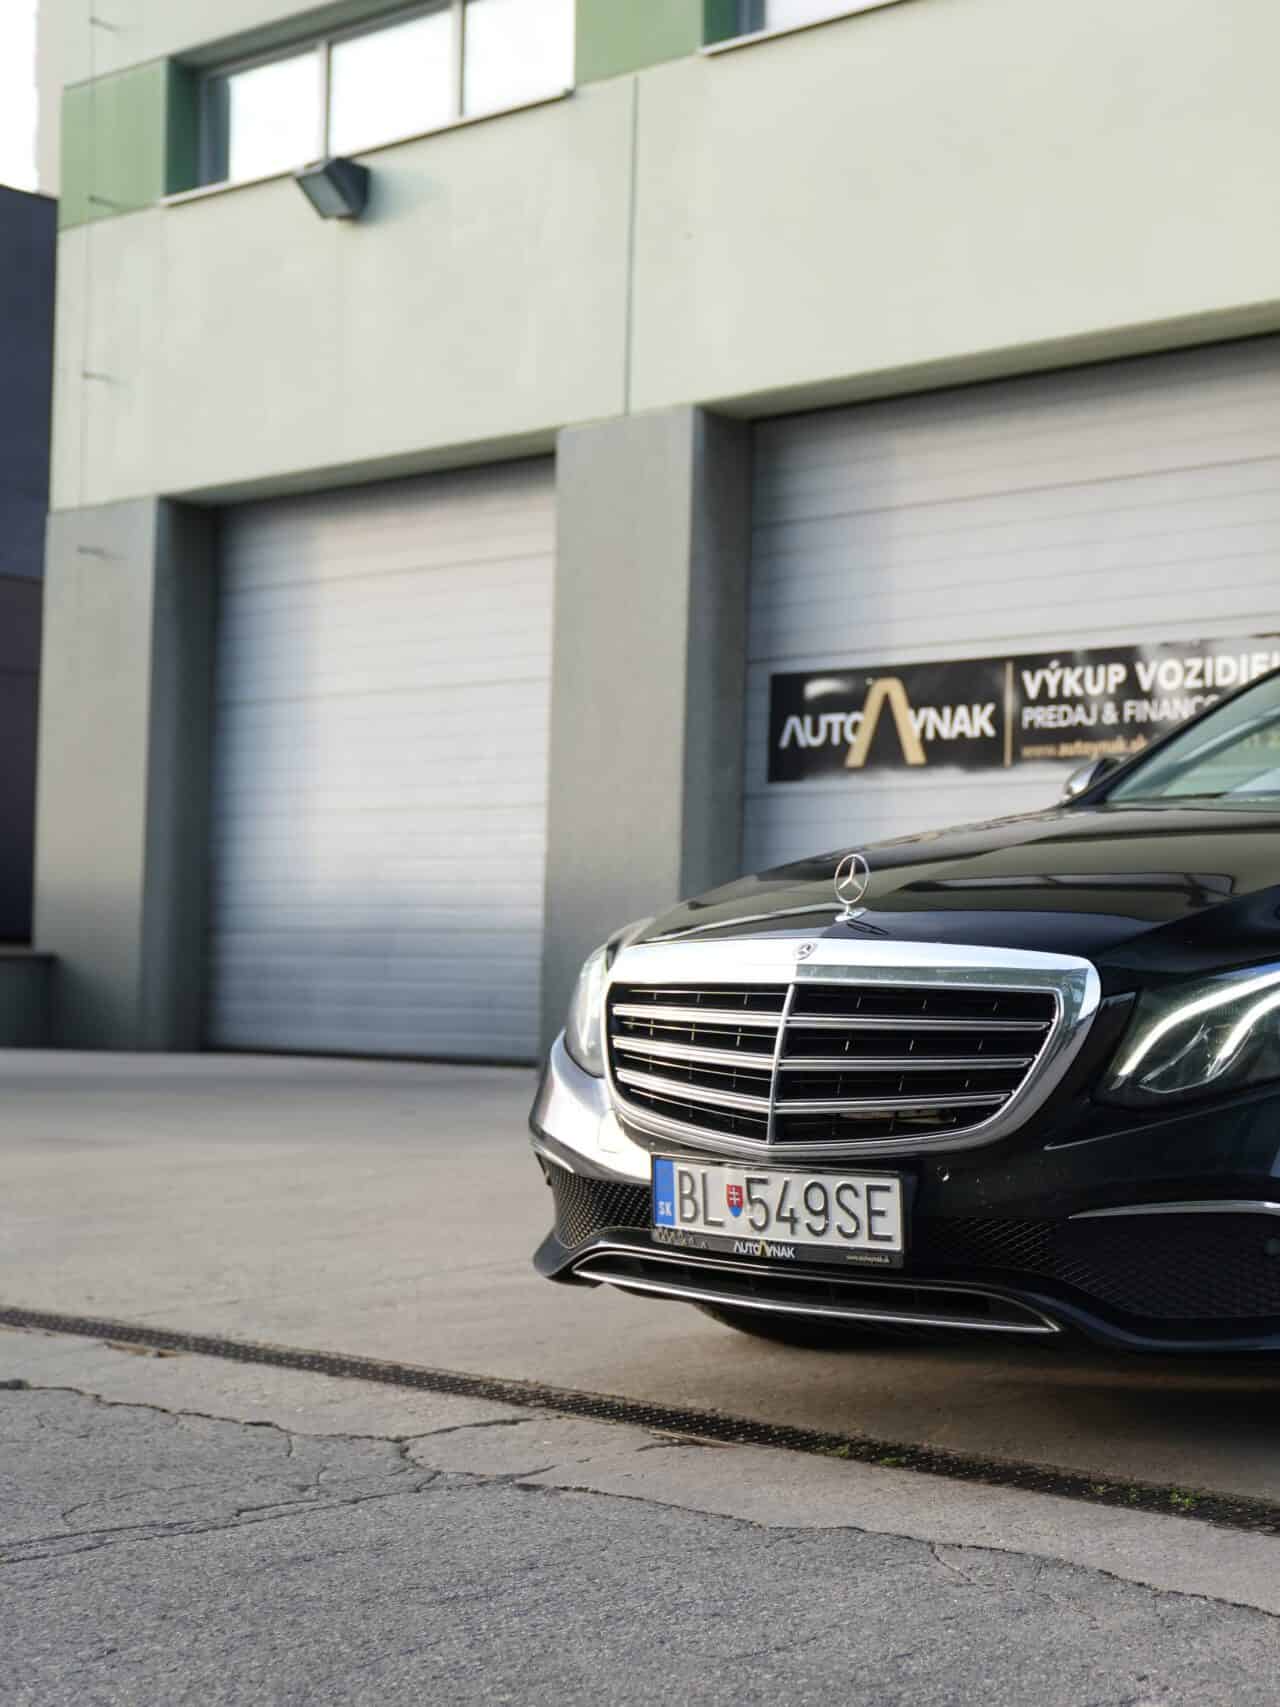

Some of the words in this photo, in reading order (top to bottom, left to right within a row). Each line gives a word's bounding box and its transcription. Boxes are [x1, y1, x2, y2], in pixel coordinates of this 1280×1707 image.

[1022, 660, 1127, 700] VÝKUP
[1022, 703, 1099, 730] PREDAJ
[1102, 701, 1119, 725] &
[658, 1200, 673, 1217] SK
[677, 1166, 725, 1228] BL
[743, 1174, 895, 1242] 549SE
